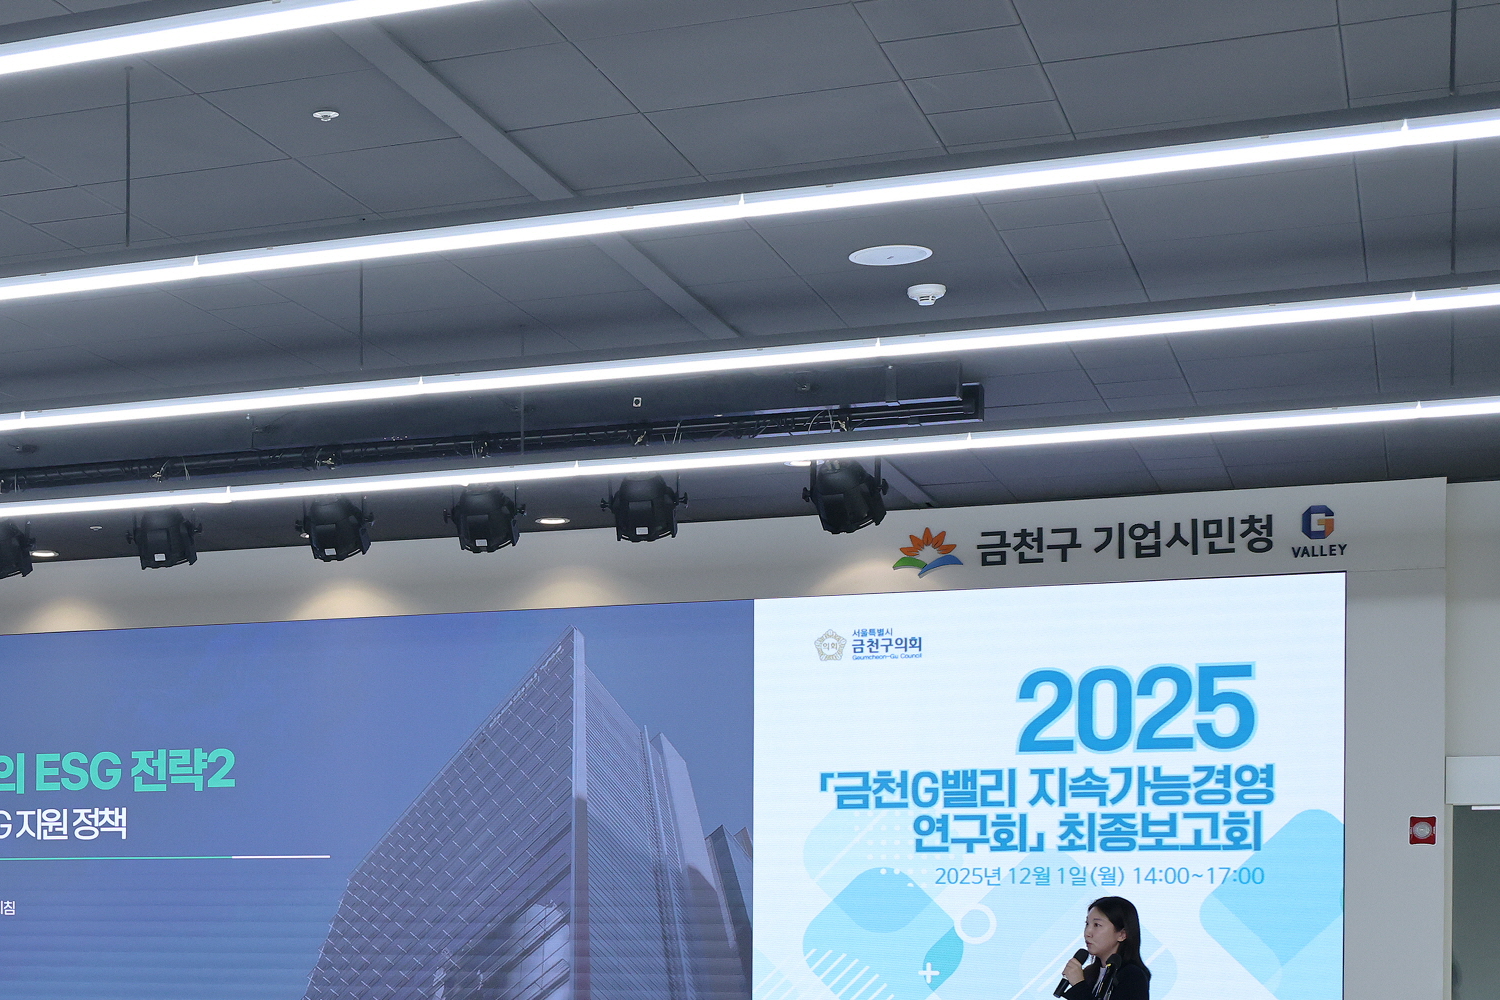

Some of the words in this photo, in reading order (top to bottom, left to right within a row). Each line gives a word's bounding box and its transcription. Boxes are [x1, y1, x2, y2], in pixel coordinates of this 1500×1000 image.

[976, 526, 1083, 567] 금천구
[1094, 514, 1274, 560] 기업시민청
[1291, 543, 1348, 559] VALLEY
[852, 628, 893, 637] 서울특별시
[852, 637, 922, 653] 금천구의회
[1016, 662, 1257, 754] 2025
[35, 751, 122, 791] ESG
[130, 747, 236, 792] 전략2
[1028, 763, 1275, 807] 지속가능경영
[15, 808, 68, 841] 지원
[72, 807, 127, 840] 정책
[1057, 810, 1262, 852] 최종보고회
[935, 866, 1001, 886] 2025년
[1008, 866, 1050, 886] 12월
[1057, 865, 1125, 888] 1일(월)
[1133, 866, 1265, 885] 14:00~17:00
